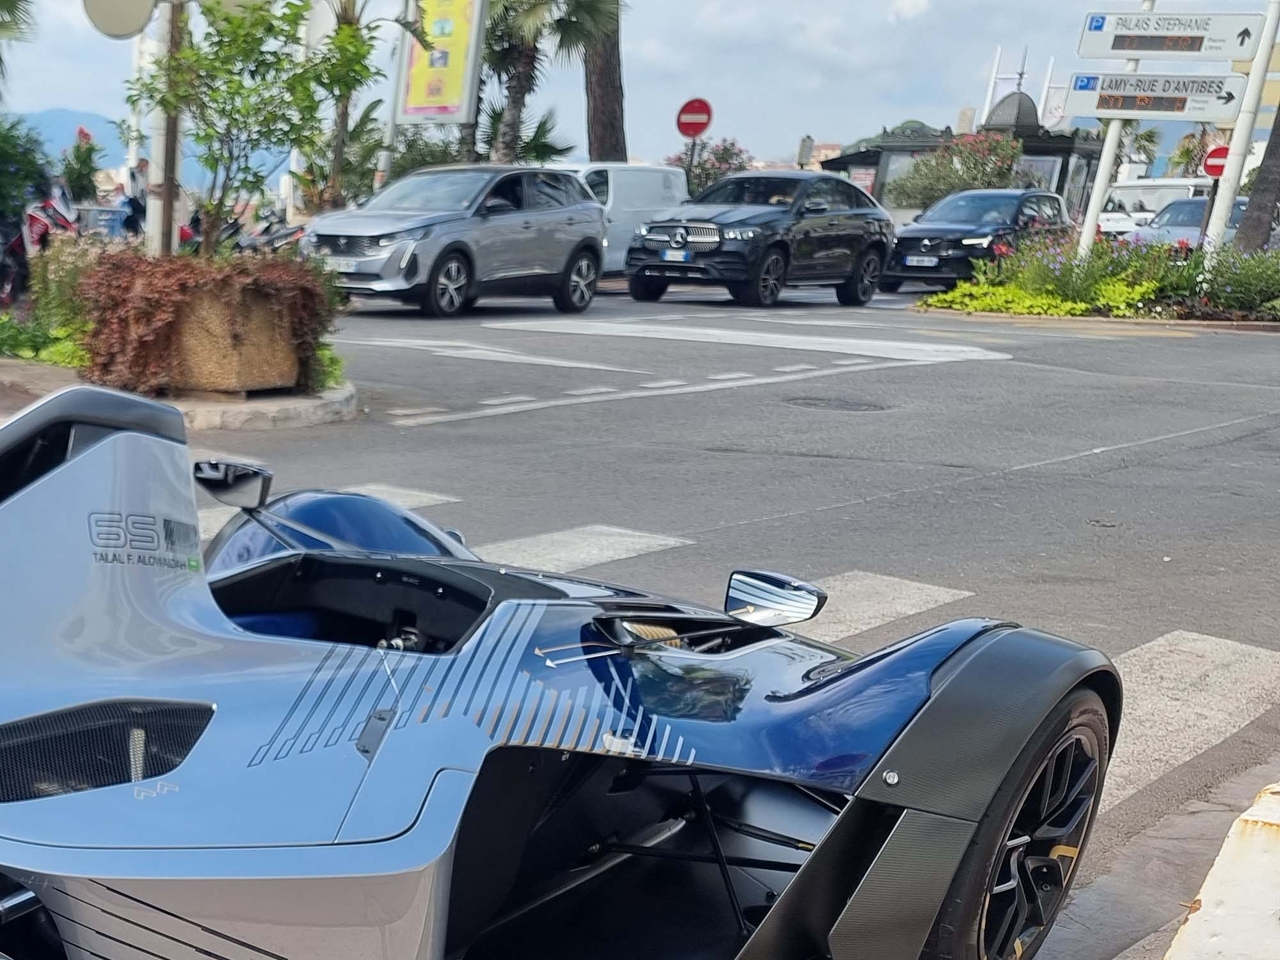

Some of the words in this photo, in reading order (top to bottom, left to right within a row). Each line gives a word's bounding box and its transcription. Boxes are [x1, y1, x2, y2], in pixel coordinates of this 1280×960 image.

[1115, 17, 1150, 31] PALAIS
[1154, 18, 1212, 32] STEPHANIE
[1101, 78, 1157, 93] LAMY-RUE
[1162, 79, 1224, 95] D'ANTIBES
[92, 552, 125, 565] TALAL
